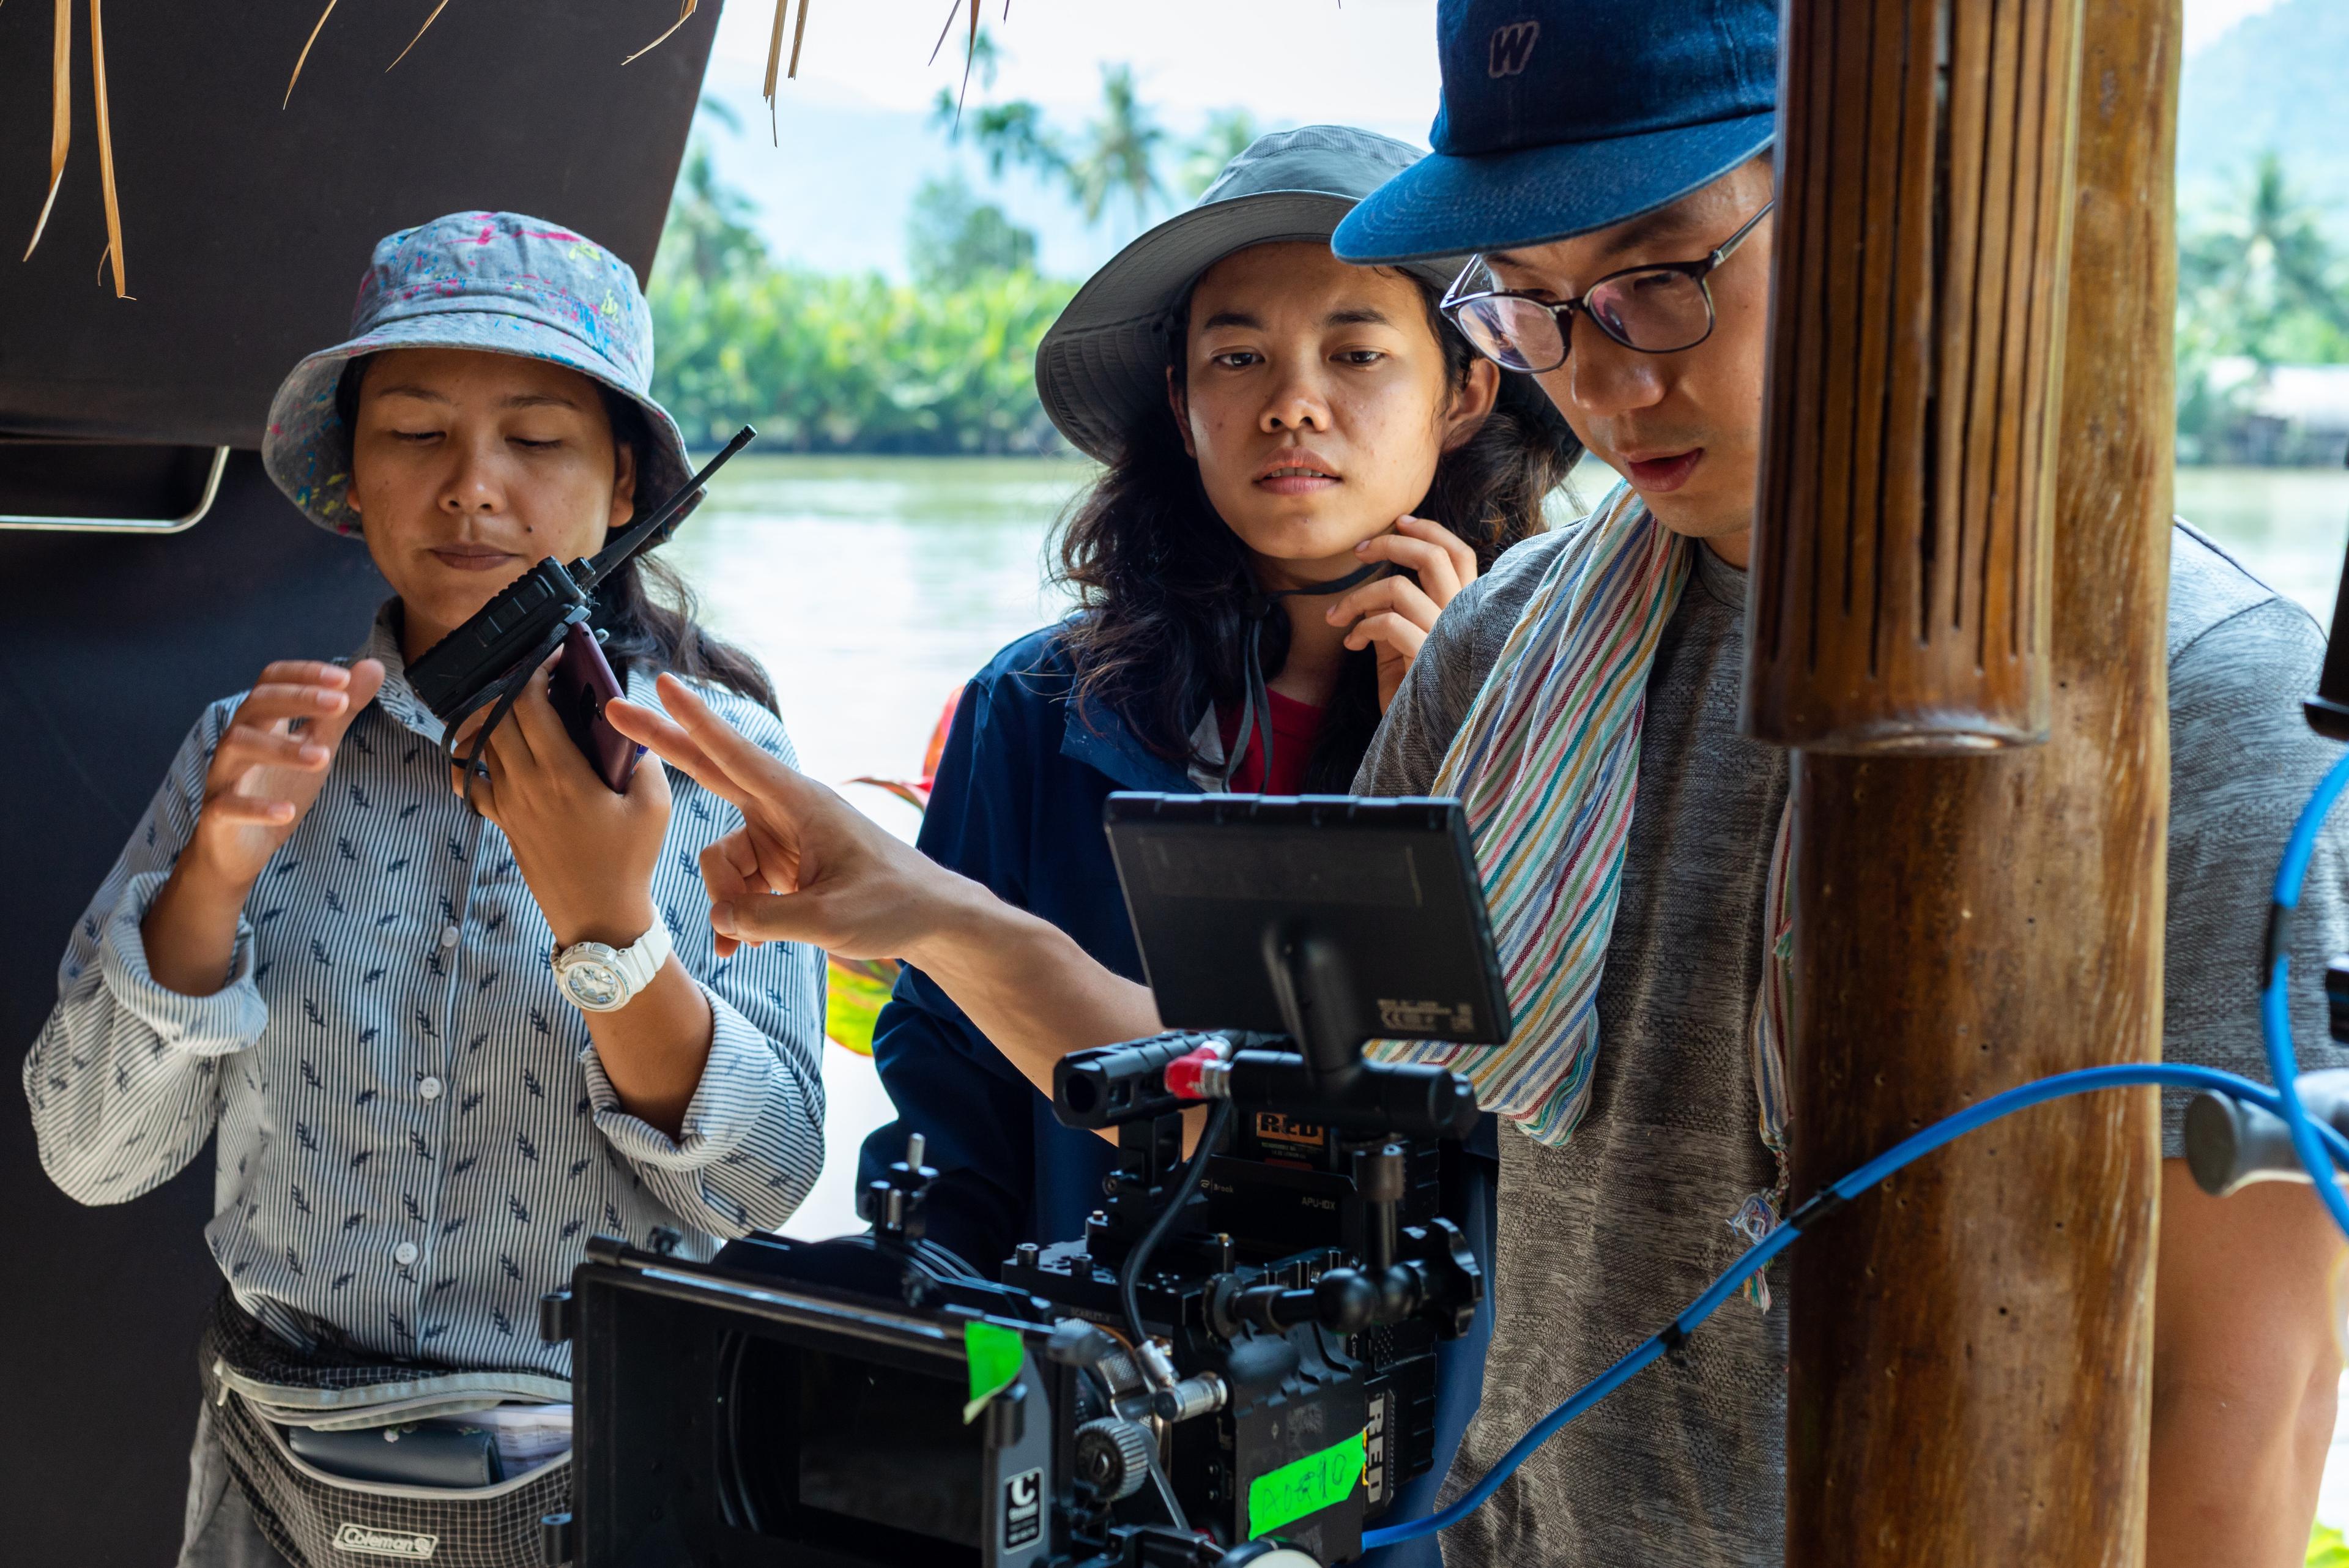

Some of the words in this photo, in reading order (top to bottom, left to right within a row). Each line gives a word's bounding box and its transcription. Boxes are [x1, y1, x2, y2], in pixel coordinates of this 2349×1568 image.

[1488, 20, 1540, 79] W
[1368, 1397, 1385, 1504] RED
[343, 1527, 414, 1551] Coleman
